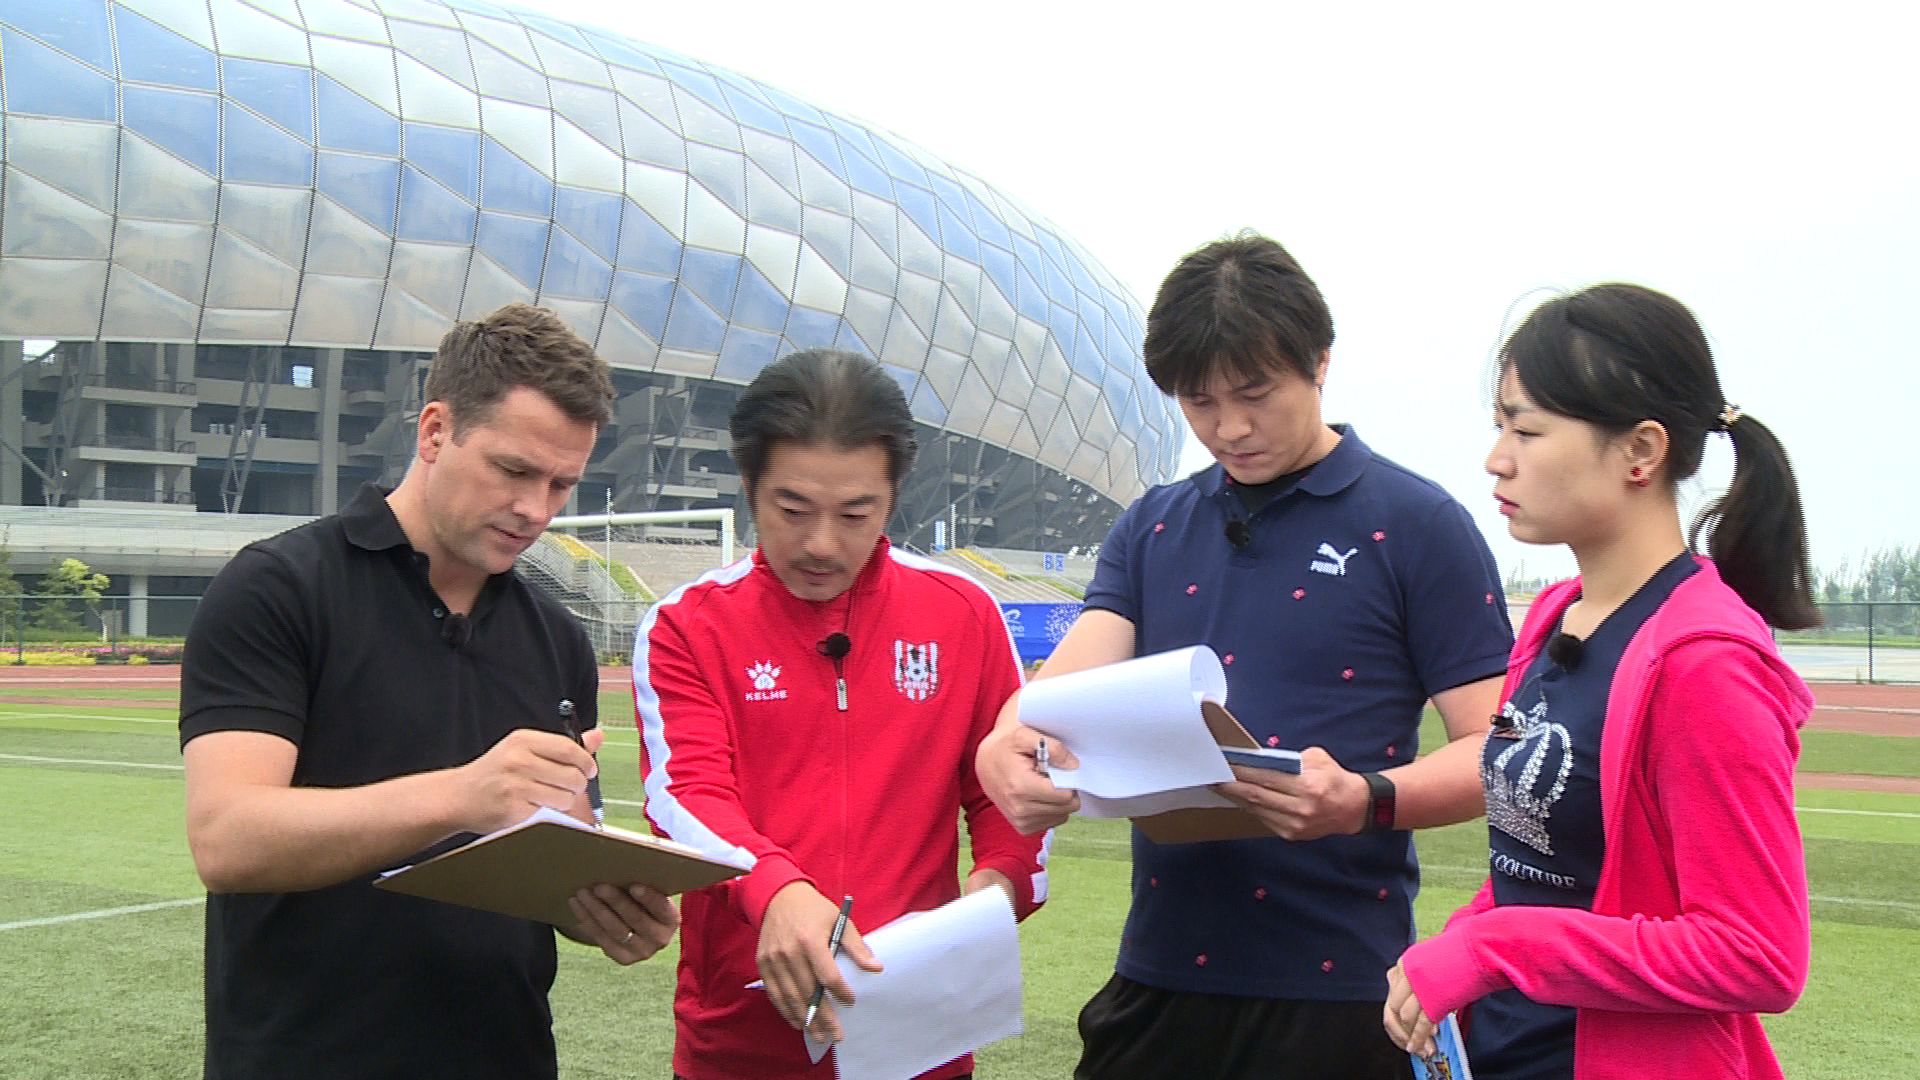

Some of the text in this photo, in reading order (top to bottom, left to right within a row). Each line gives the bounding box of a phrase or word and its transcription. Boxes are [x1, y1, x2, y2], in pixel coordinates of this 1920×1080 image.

[1310, 560, 1340, 577] PUMA
[745, 689, 788, 702] KELME
[1495, 855, 1577, 889] COUTURE
